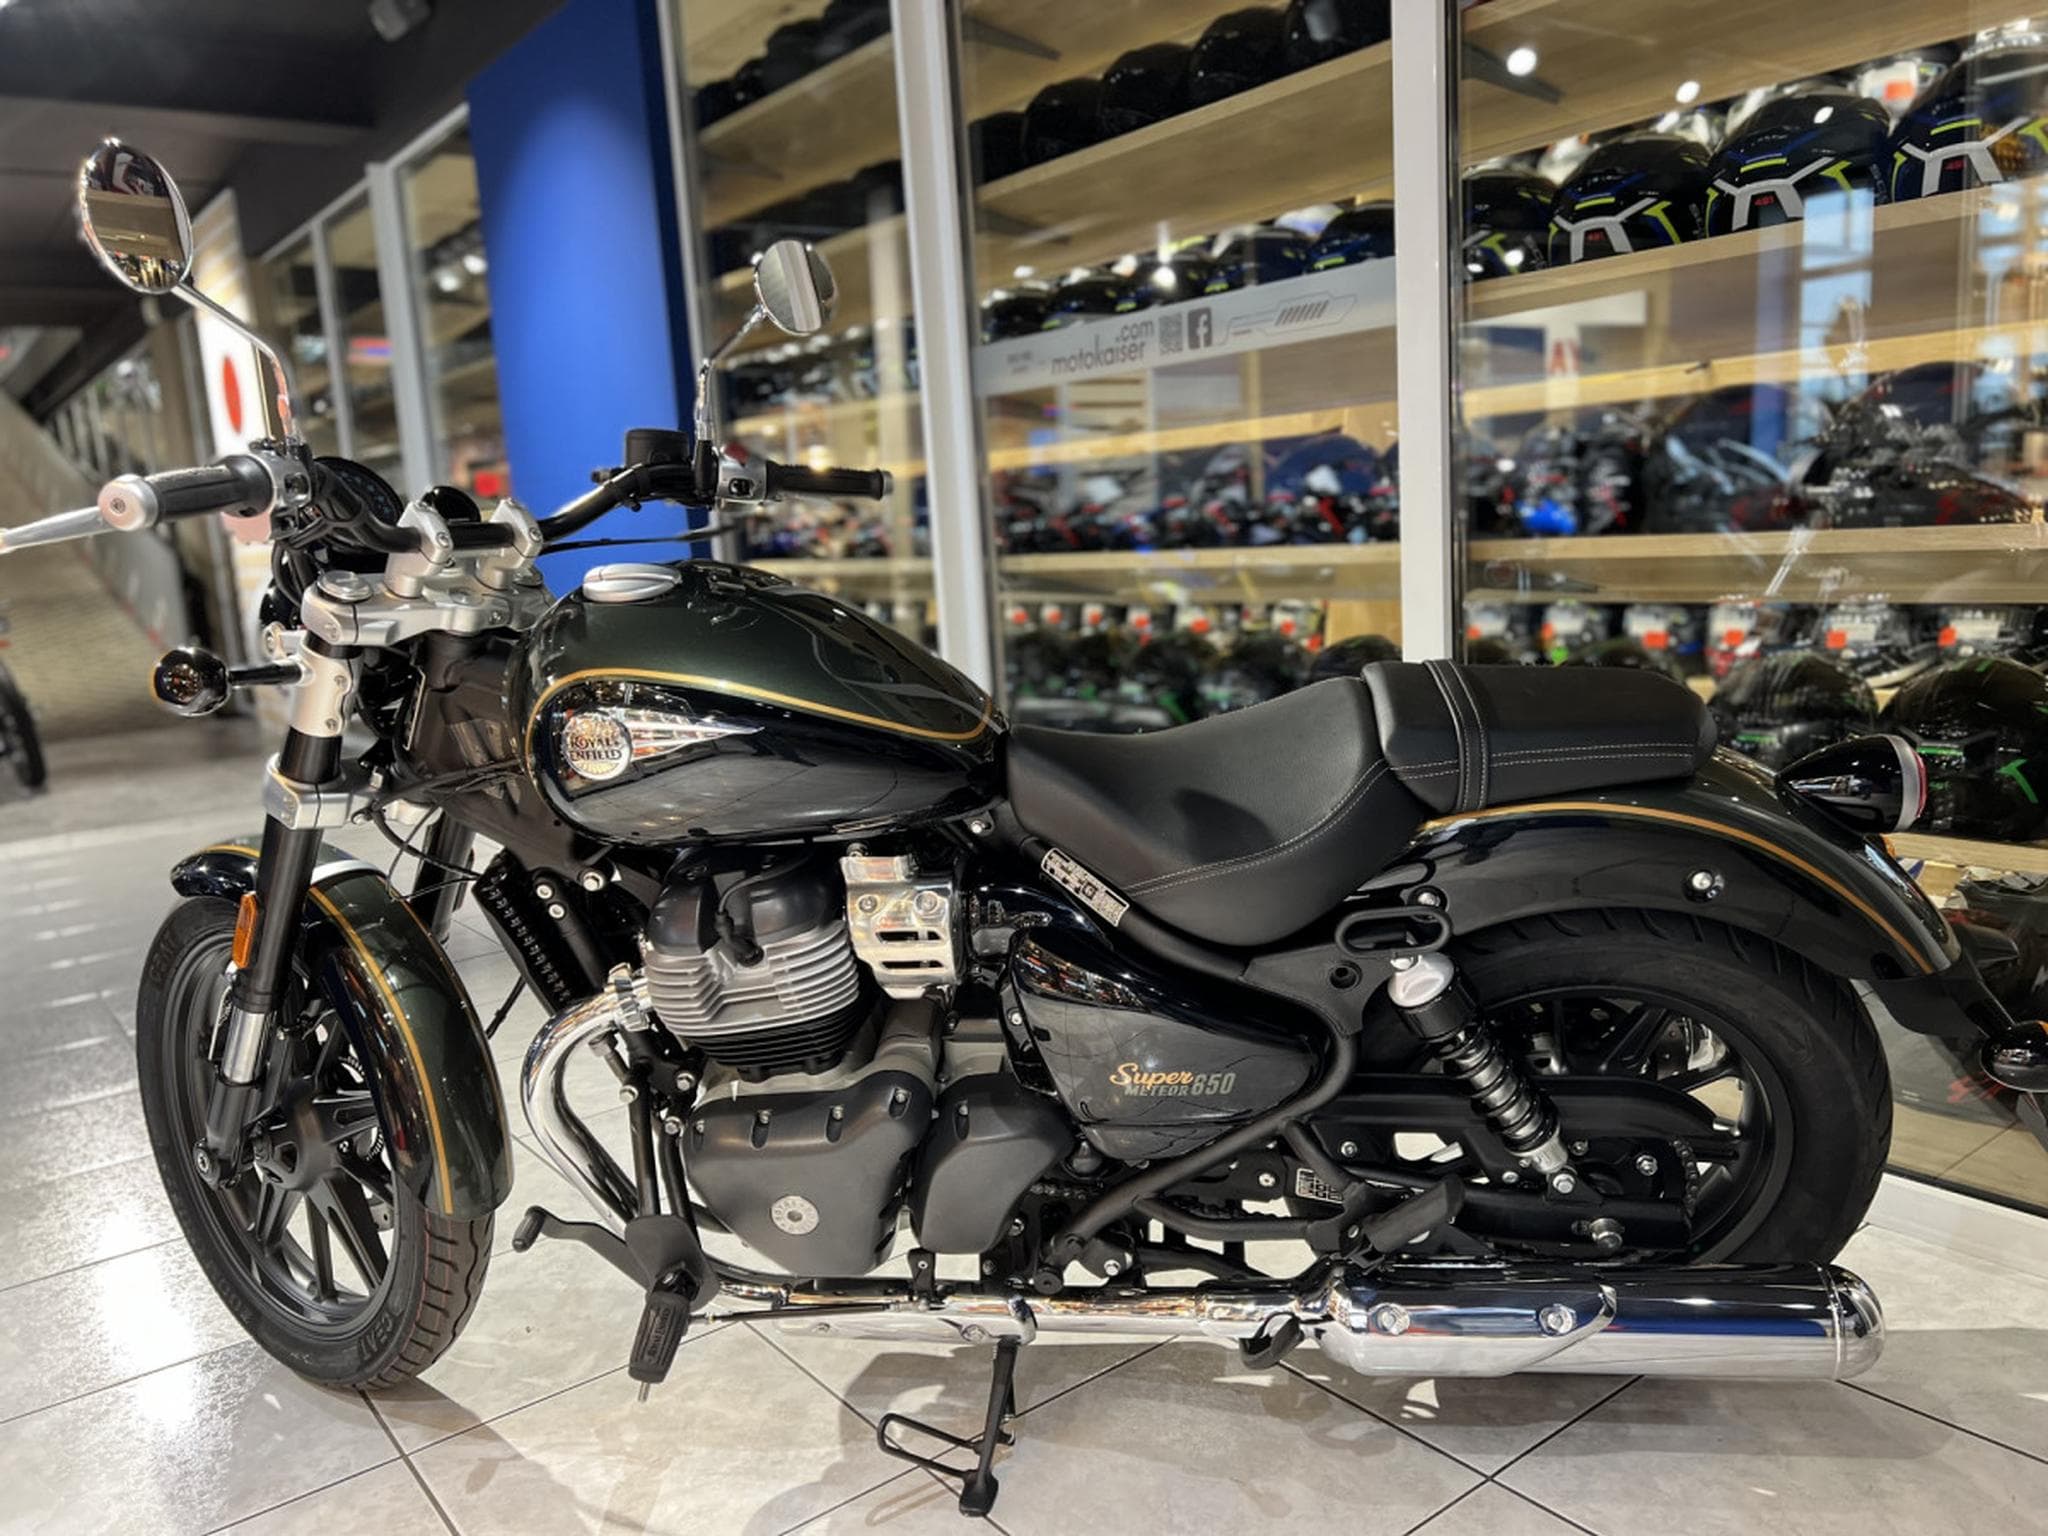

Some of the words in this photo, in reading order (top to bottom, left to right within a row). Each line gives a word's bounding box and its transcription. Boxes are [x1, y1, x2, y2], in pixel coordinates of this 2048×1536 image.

[1115, 320, 1155, 343] .com
[1051, 334, 1147, 375] motokaiser
[569, 734, 613, 749] ROYAL
[569, 749, 622, 761] ENFIELD
[1109, 1063, 1194, 1089] Super
[1124, 1083, 1190, 1097] METEOR
